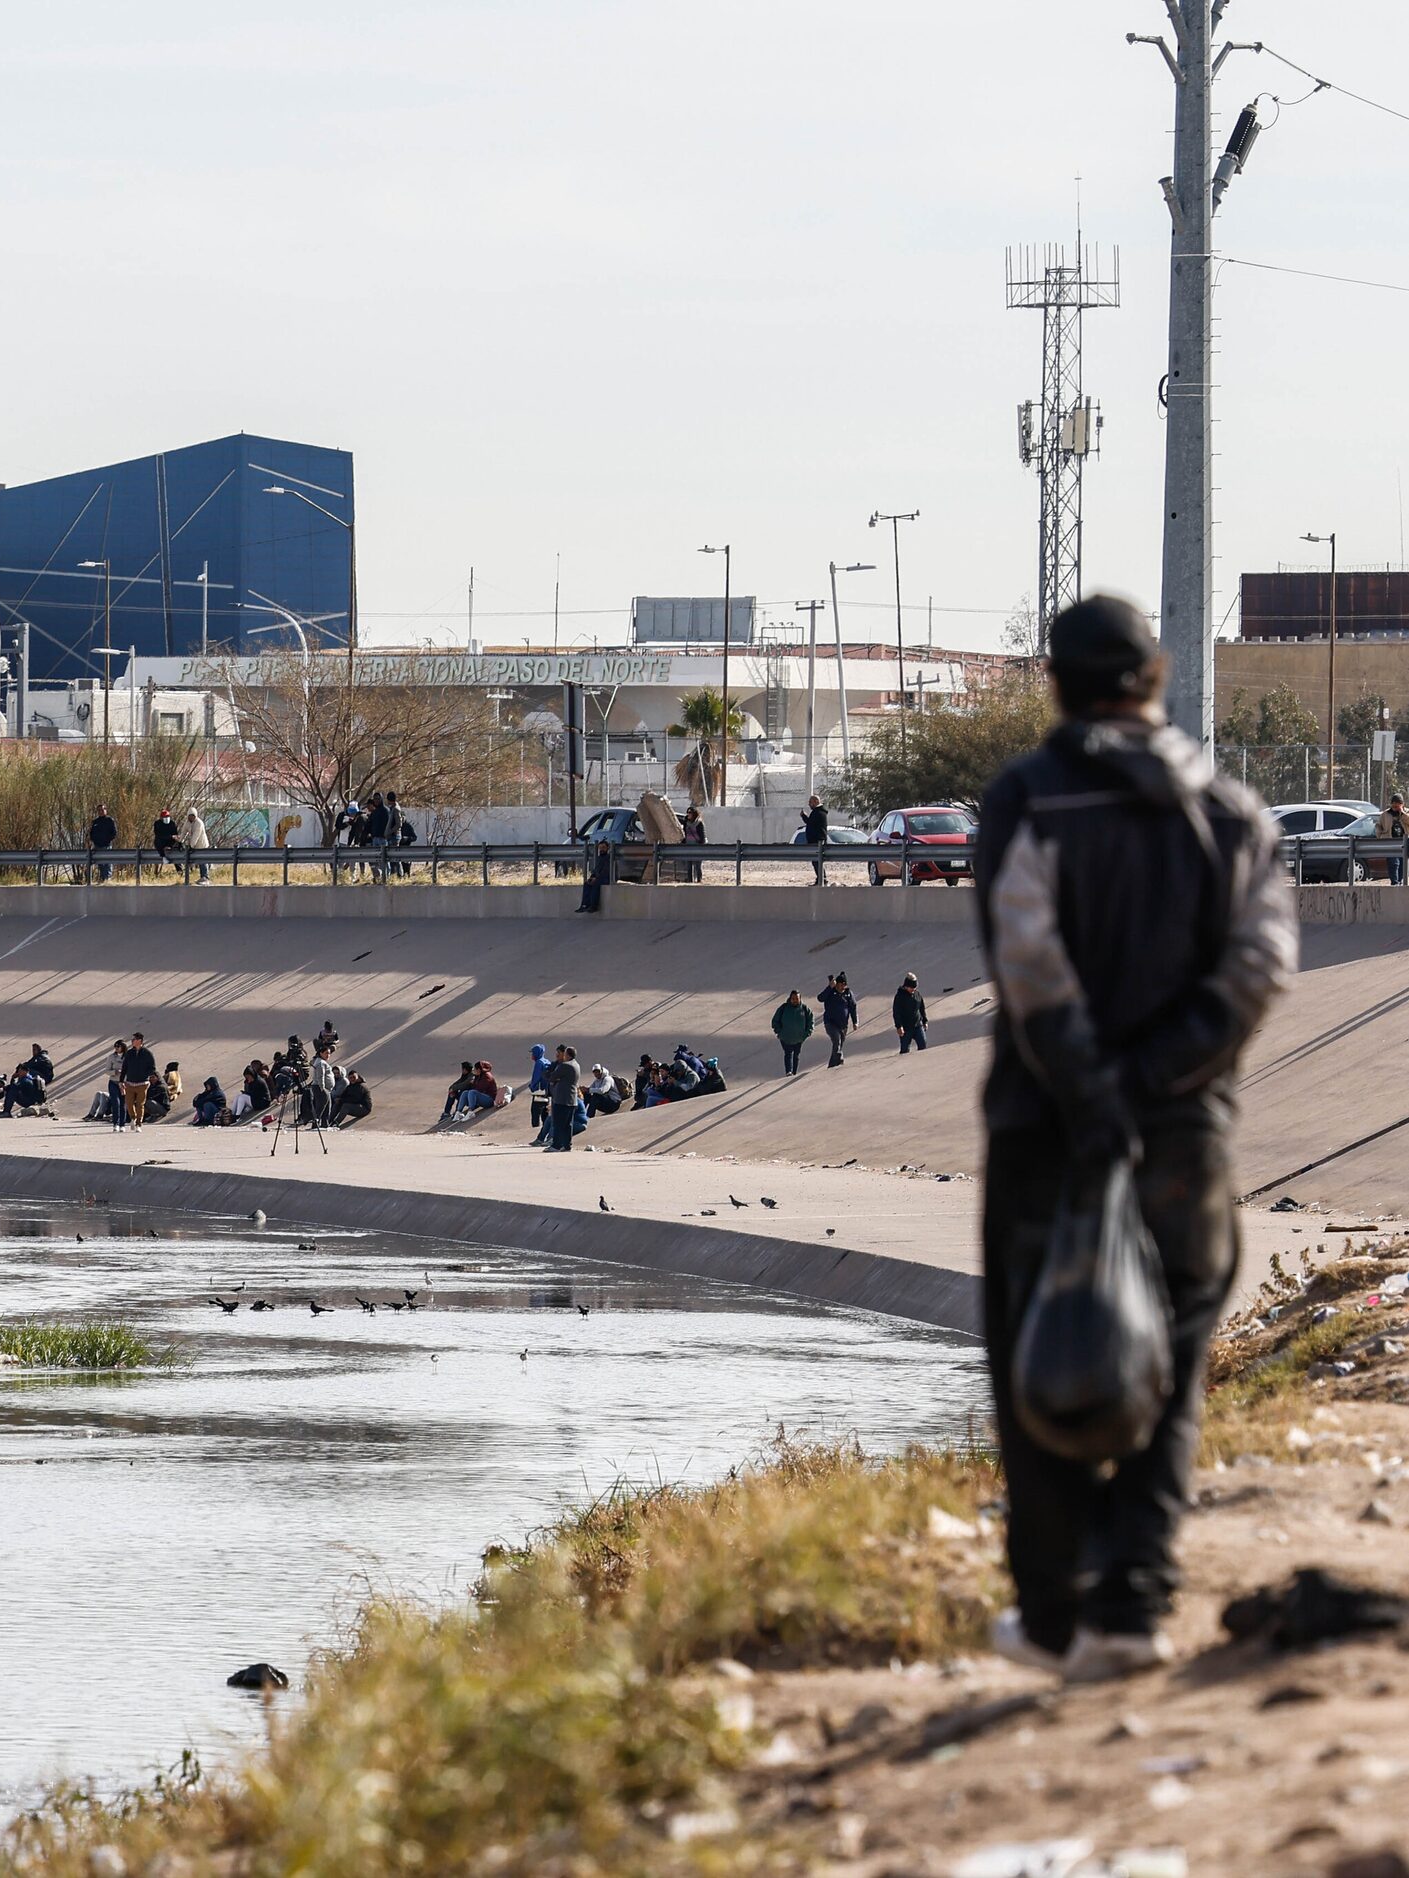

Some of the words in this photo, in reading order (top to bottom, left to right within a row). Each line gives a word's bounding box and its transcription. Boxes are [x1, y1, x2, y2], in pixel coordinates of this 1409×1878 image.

[494, 658, 551, 683] PASO
[556, 657, 594, 683] DEL
[600, 657, 672, 683] NORTE
